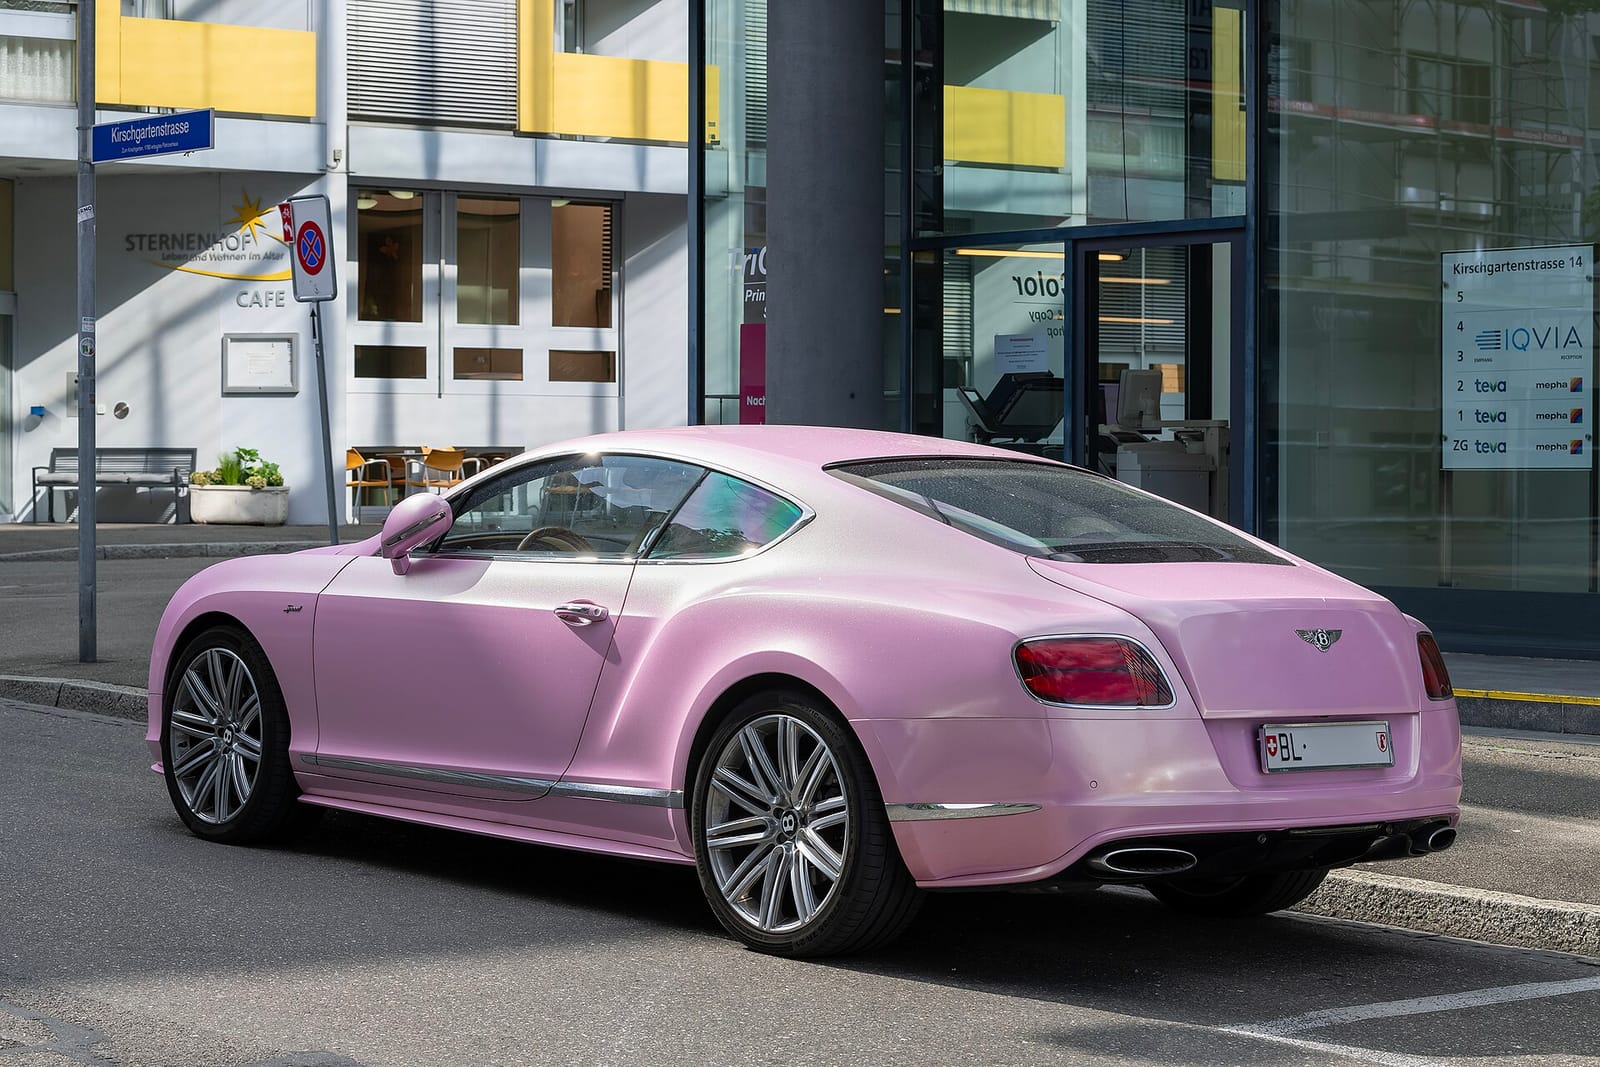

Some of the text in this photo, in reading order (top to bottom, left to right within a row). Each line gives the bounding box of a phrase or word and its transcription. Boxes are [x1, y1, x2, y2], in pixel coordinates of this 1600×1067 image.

[111, 121, 190, 144] Kirschgartenstrasse
[124, 233, 251, 252] STERNENHOF
[162, 252, 285, 262] Leben und Wohnen im Alter
[1453, 255, 1583, 276] Kirschgartenstrasse 14
[236, 290, 285, 308] CAFE
[1457, 290, 1464, 302] 5
[1456, 320, 1583, 352] 4 IQVIA
[1457, 351, 1464, 362] 3
[1457, 378, 1568, 393] 2 teva mepha
[1457, 409, 1568, 424] 1 teva mepha
[1453, 439, 1568, 454] ZG teva mepha
